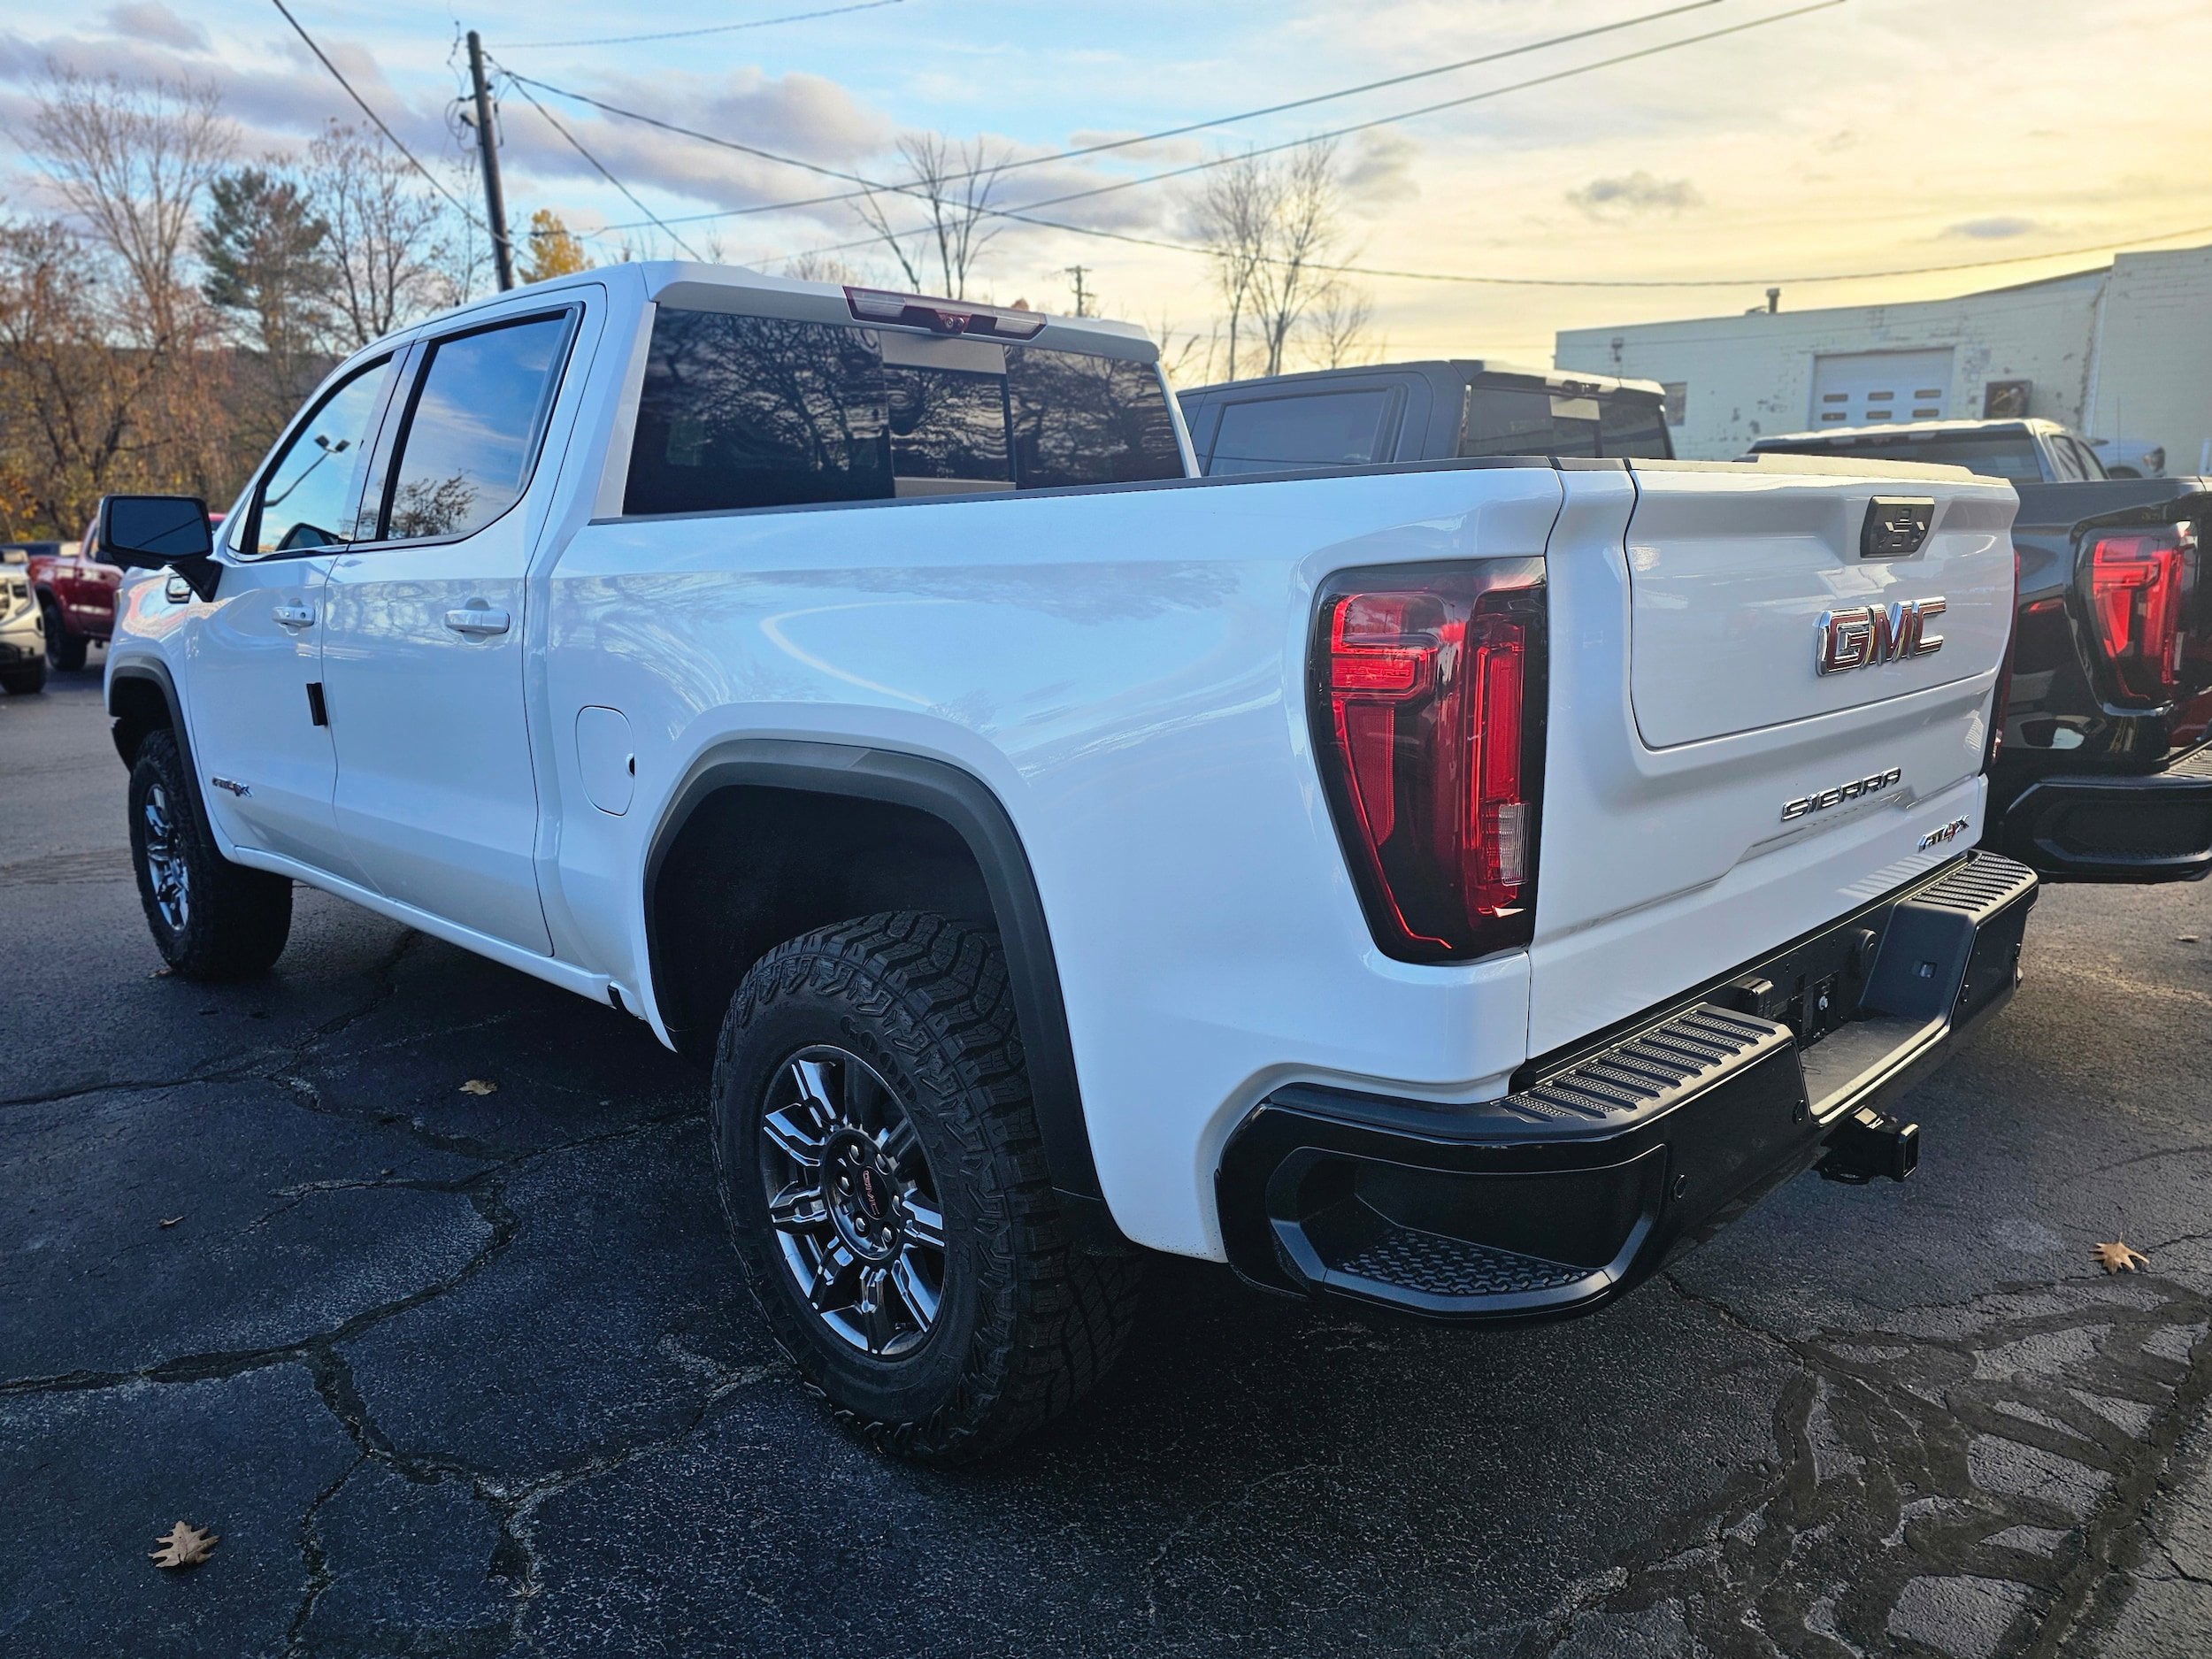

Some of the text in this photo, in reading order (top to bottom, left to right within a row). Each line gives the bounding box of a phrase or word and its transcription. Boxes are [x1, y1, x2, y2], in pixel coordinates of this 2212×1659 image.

[1814, 596, 1946, 677] GMC
[1781, 767, 1901, 822] SIERRA
[1917, 815, 1970, 852] AT4X
[863, 1170, 880, 1216] GMC
